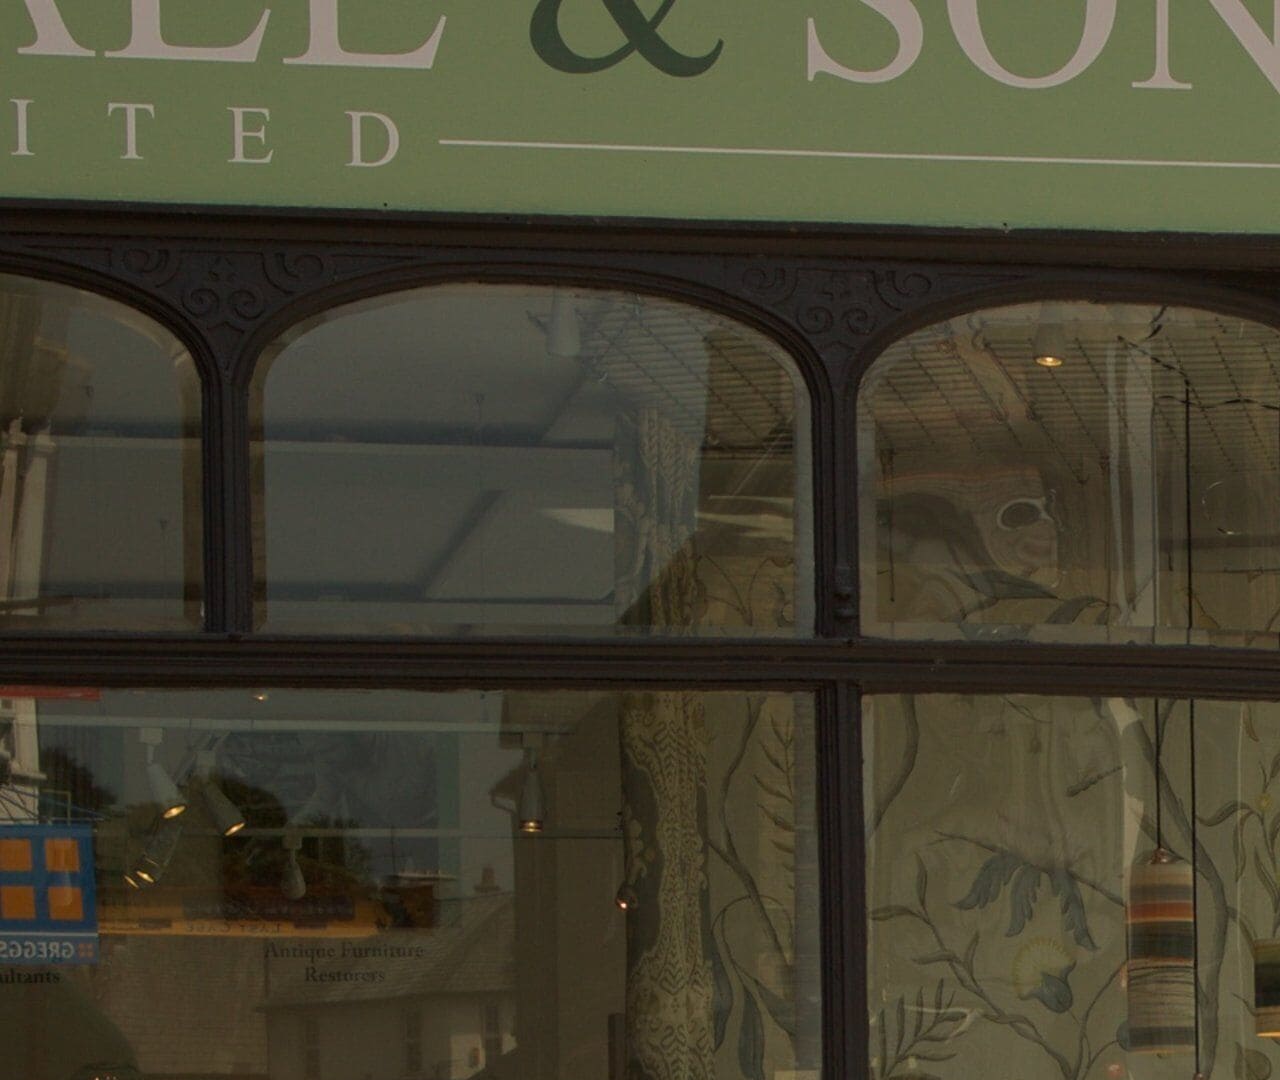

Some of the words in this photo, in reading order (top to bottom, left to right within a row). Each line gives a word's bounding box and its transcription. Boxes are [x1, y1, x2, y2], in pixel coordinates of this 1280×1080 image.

[264, 942, 336, 964] Antique
[341, 942, 425, 958] Furniture
[305, 967, 386, 982] Restorers
